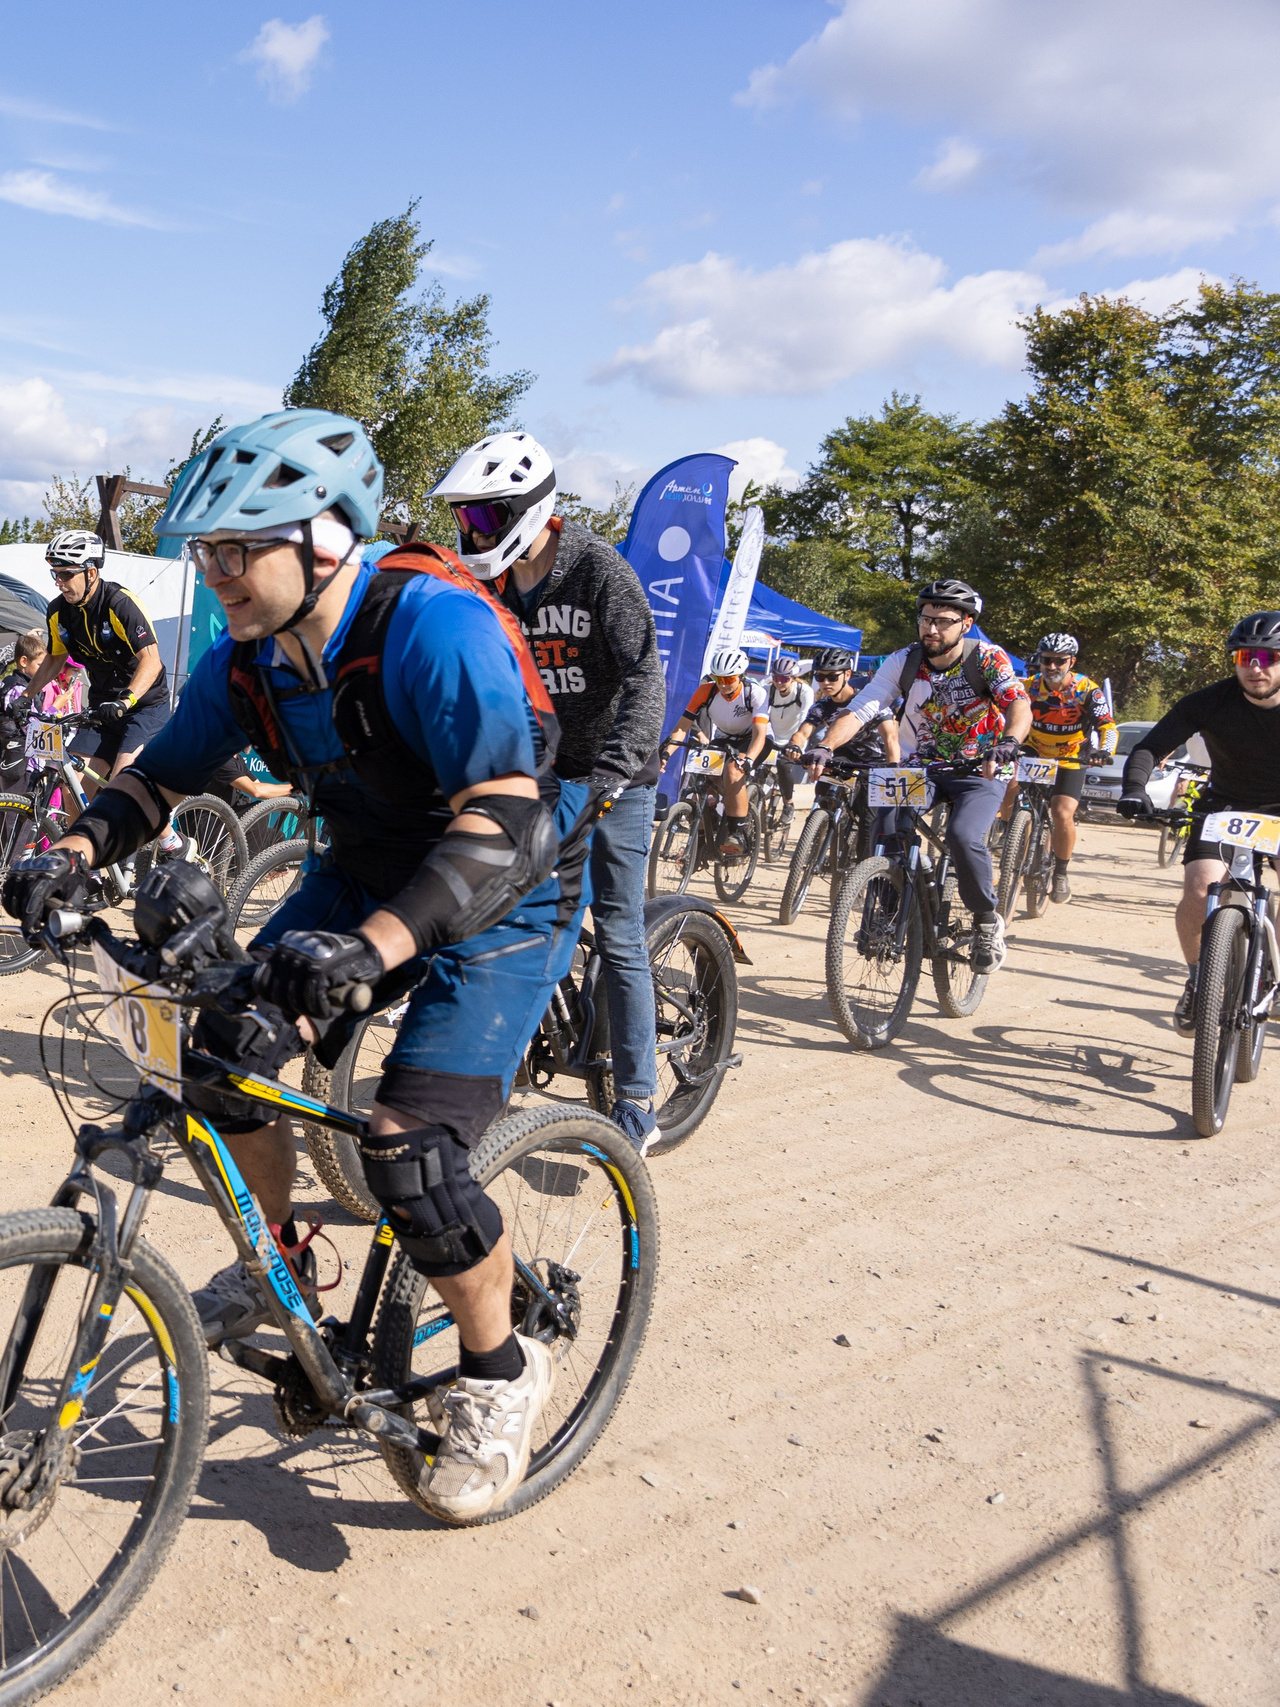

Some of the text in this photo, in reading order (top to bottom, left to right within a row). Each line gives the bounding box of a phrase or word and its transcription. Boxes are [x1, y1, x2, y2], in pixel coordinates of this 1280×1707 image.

[566, 647, 579, 658] 95
[539, 666, 587, 695] RIS
[31, 729, 55, 752] 561
[701, 755, 710, 768] 8
[1024, 763, 1051, 778] 777
[884, 777, 908, 798] 51
[1227, 817, 1261, 838] 87
